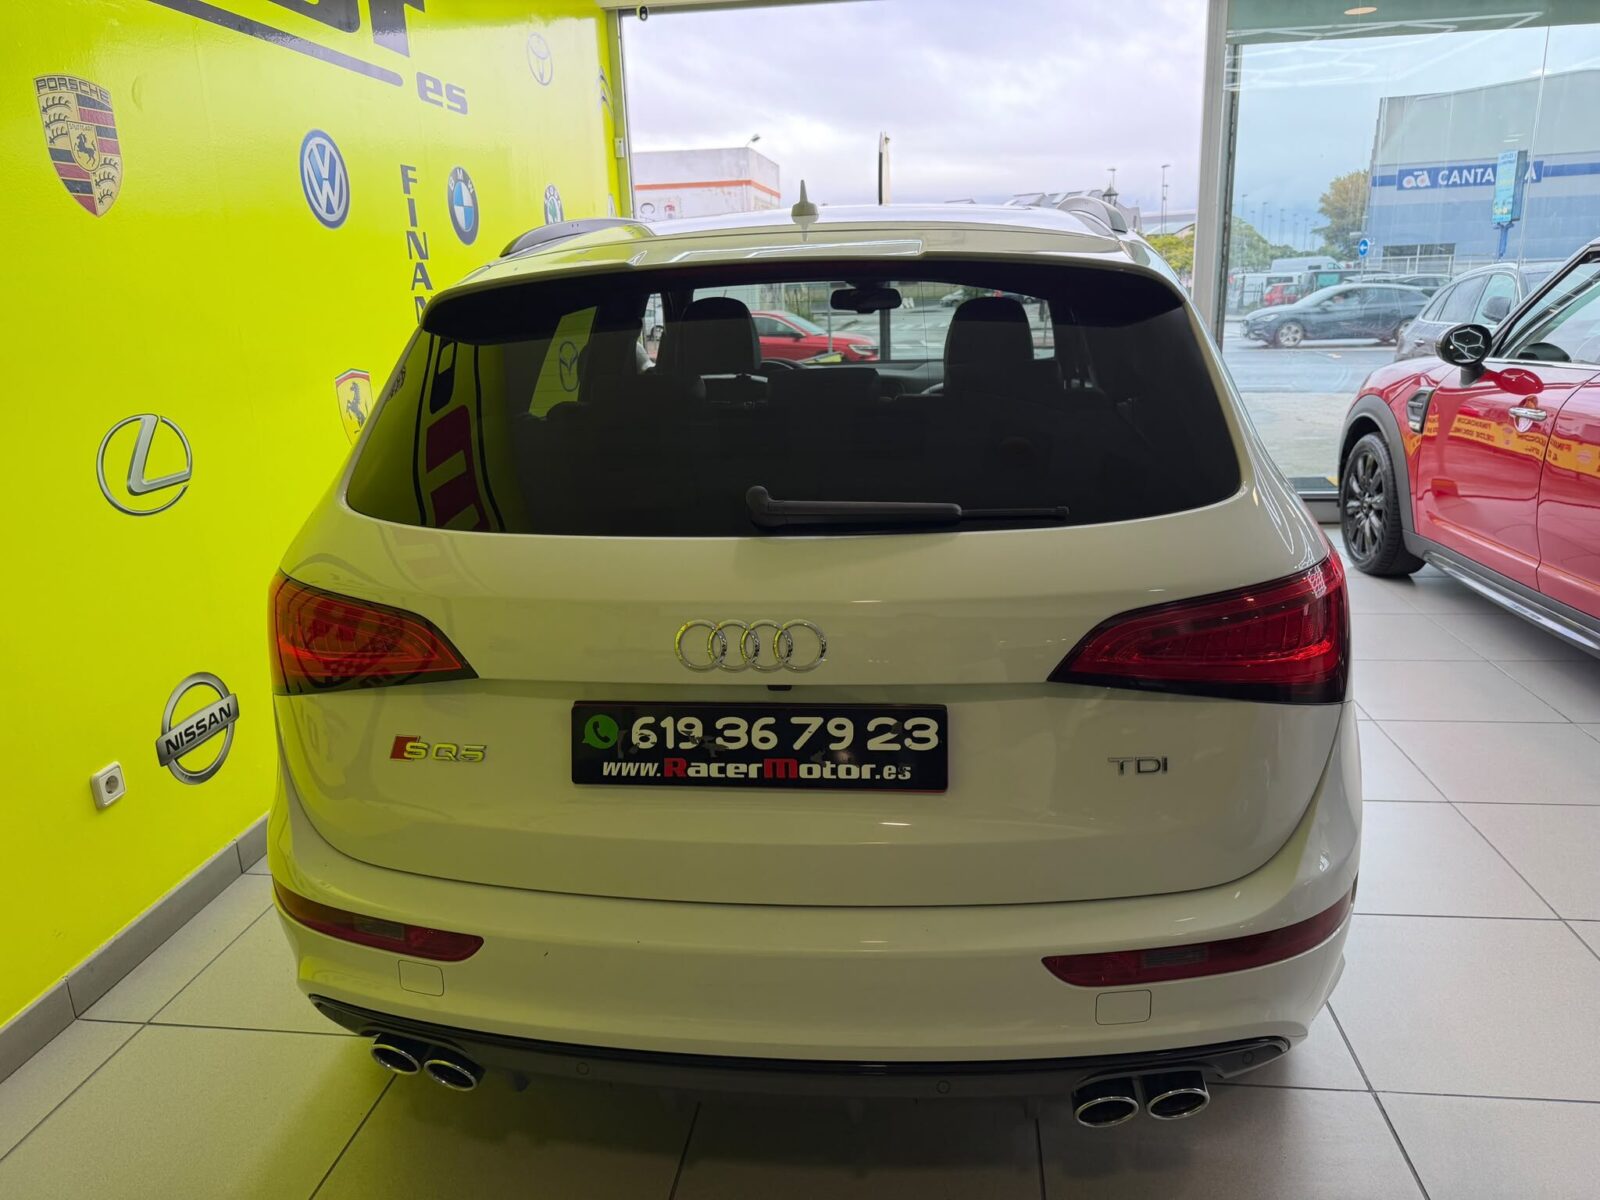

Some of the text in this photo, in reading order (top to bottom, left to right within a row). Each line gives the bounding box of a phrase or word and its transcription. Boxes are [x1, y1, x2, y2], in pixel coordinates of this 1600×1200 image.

[35, 77, 113, 106] PORSCHE
[448, 168, 475, 193] BMW
[1438, 167, 1537, 186] CANTAA
[164, 702, 232, 756] NISSAN
[631, 716, 939, 751] 619 36 79 23
[403, 741, 487, 763] SQ5
[602, 757, 912, 780] www.RacerMotor.es
[1107, 756, 1168, 776] TDI
